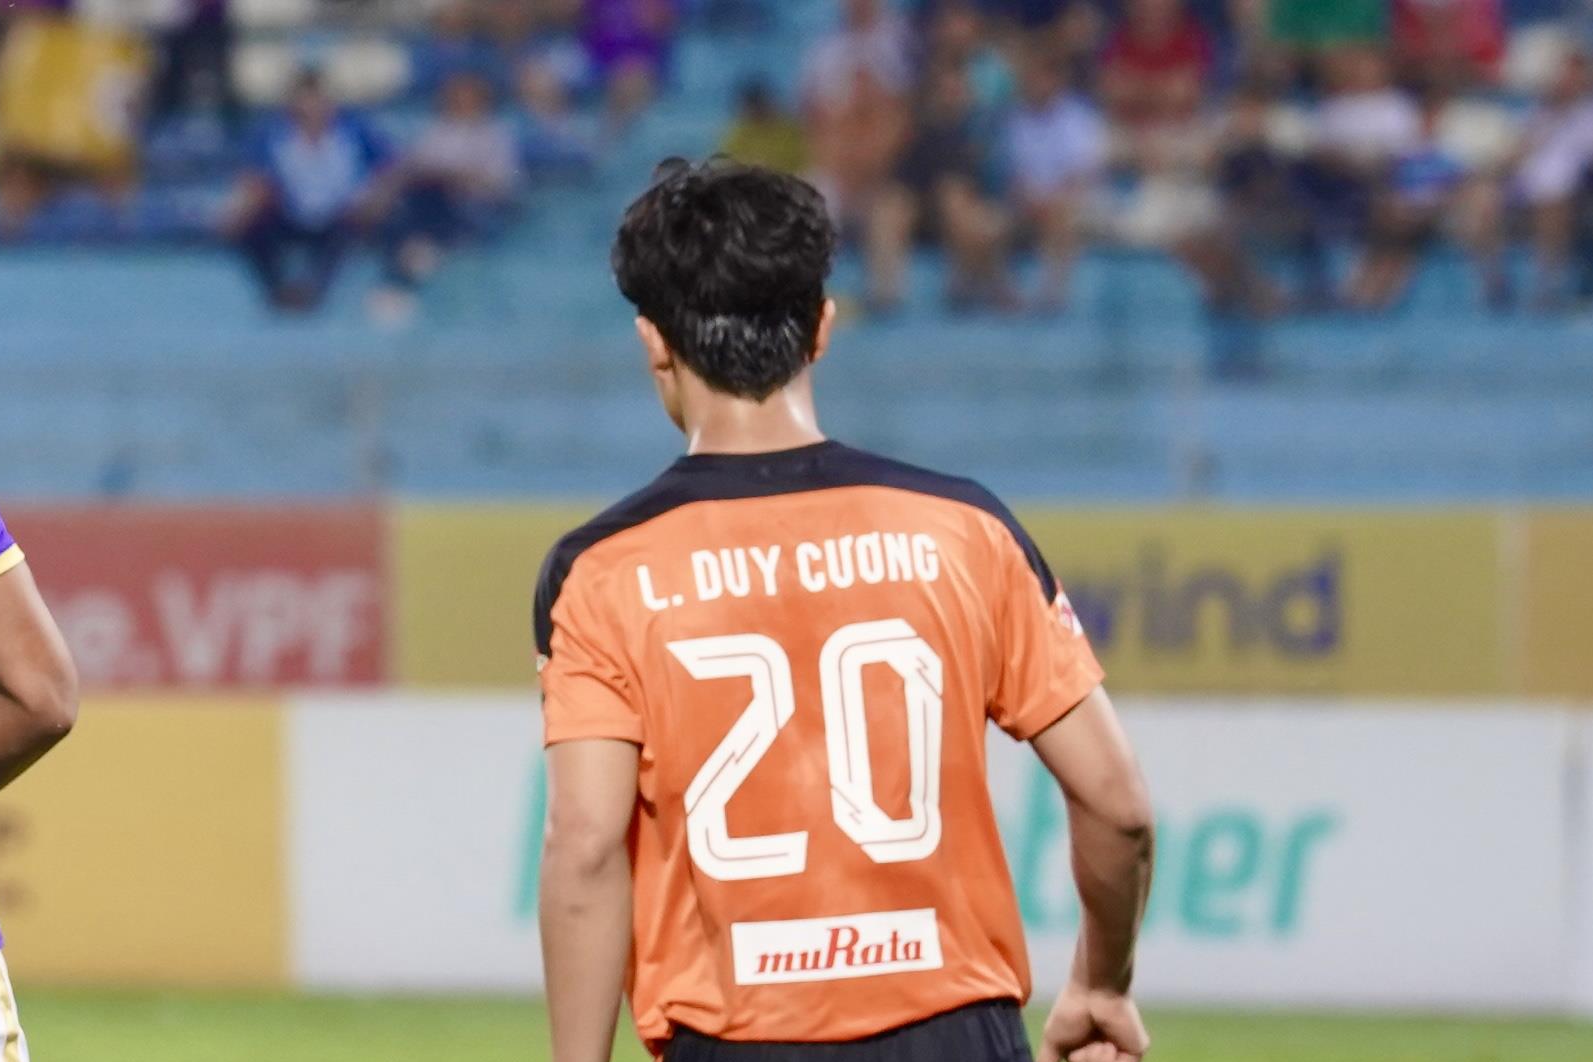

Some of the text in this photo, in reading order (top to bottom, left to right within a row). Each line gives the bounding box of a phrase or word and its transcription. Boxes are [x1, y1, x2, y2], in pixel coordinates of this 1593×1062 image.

[637, 565, 685, 611] L.
[691, 544, 781, 601] DUY
[666, 618, 943, 882] 20
[754, 925, 924, 974] muRata
